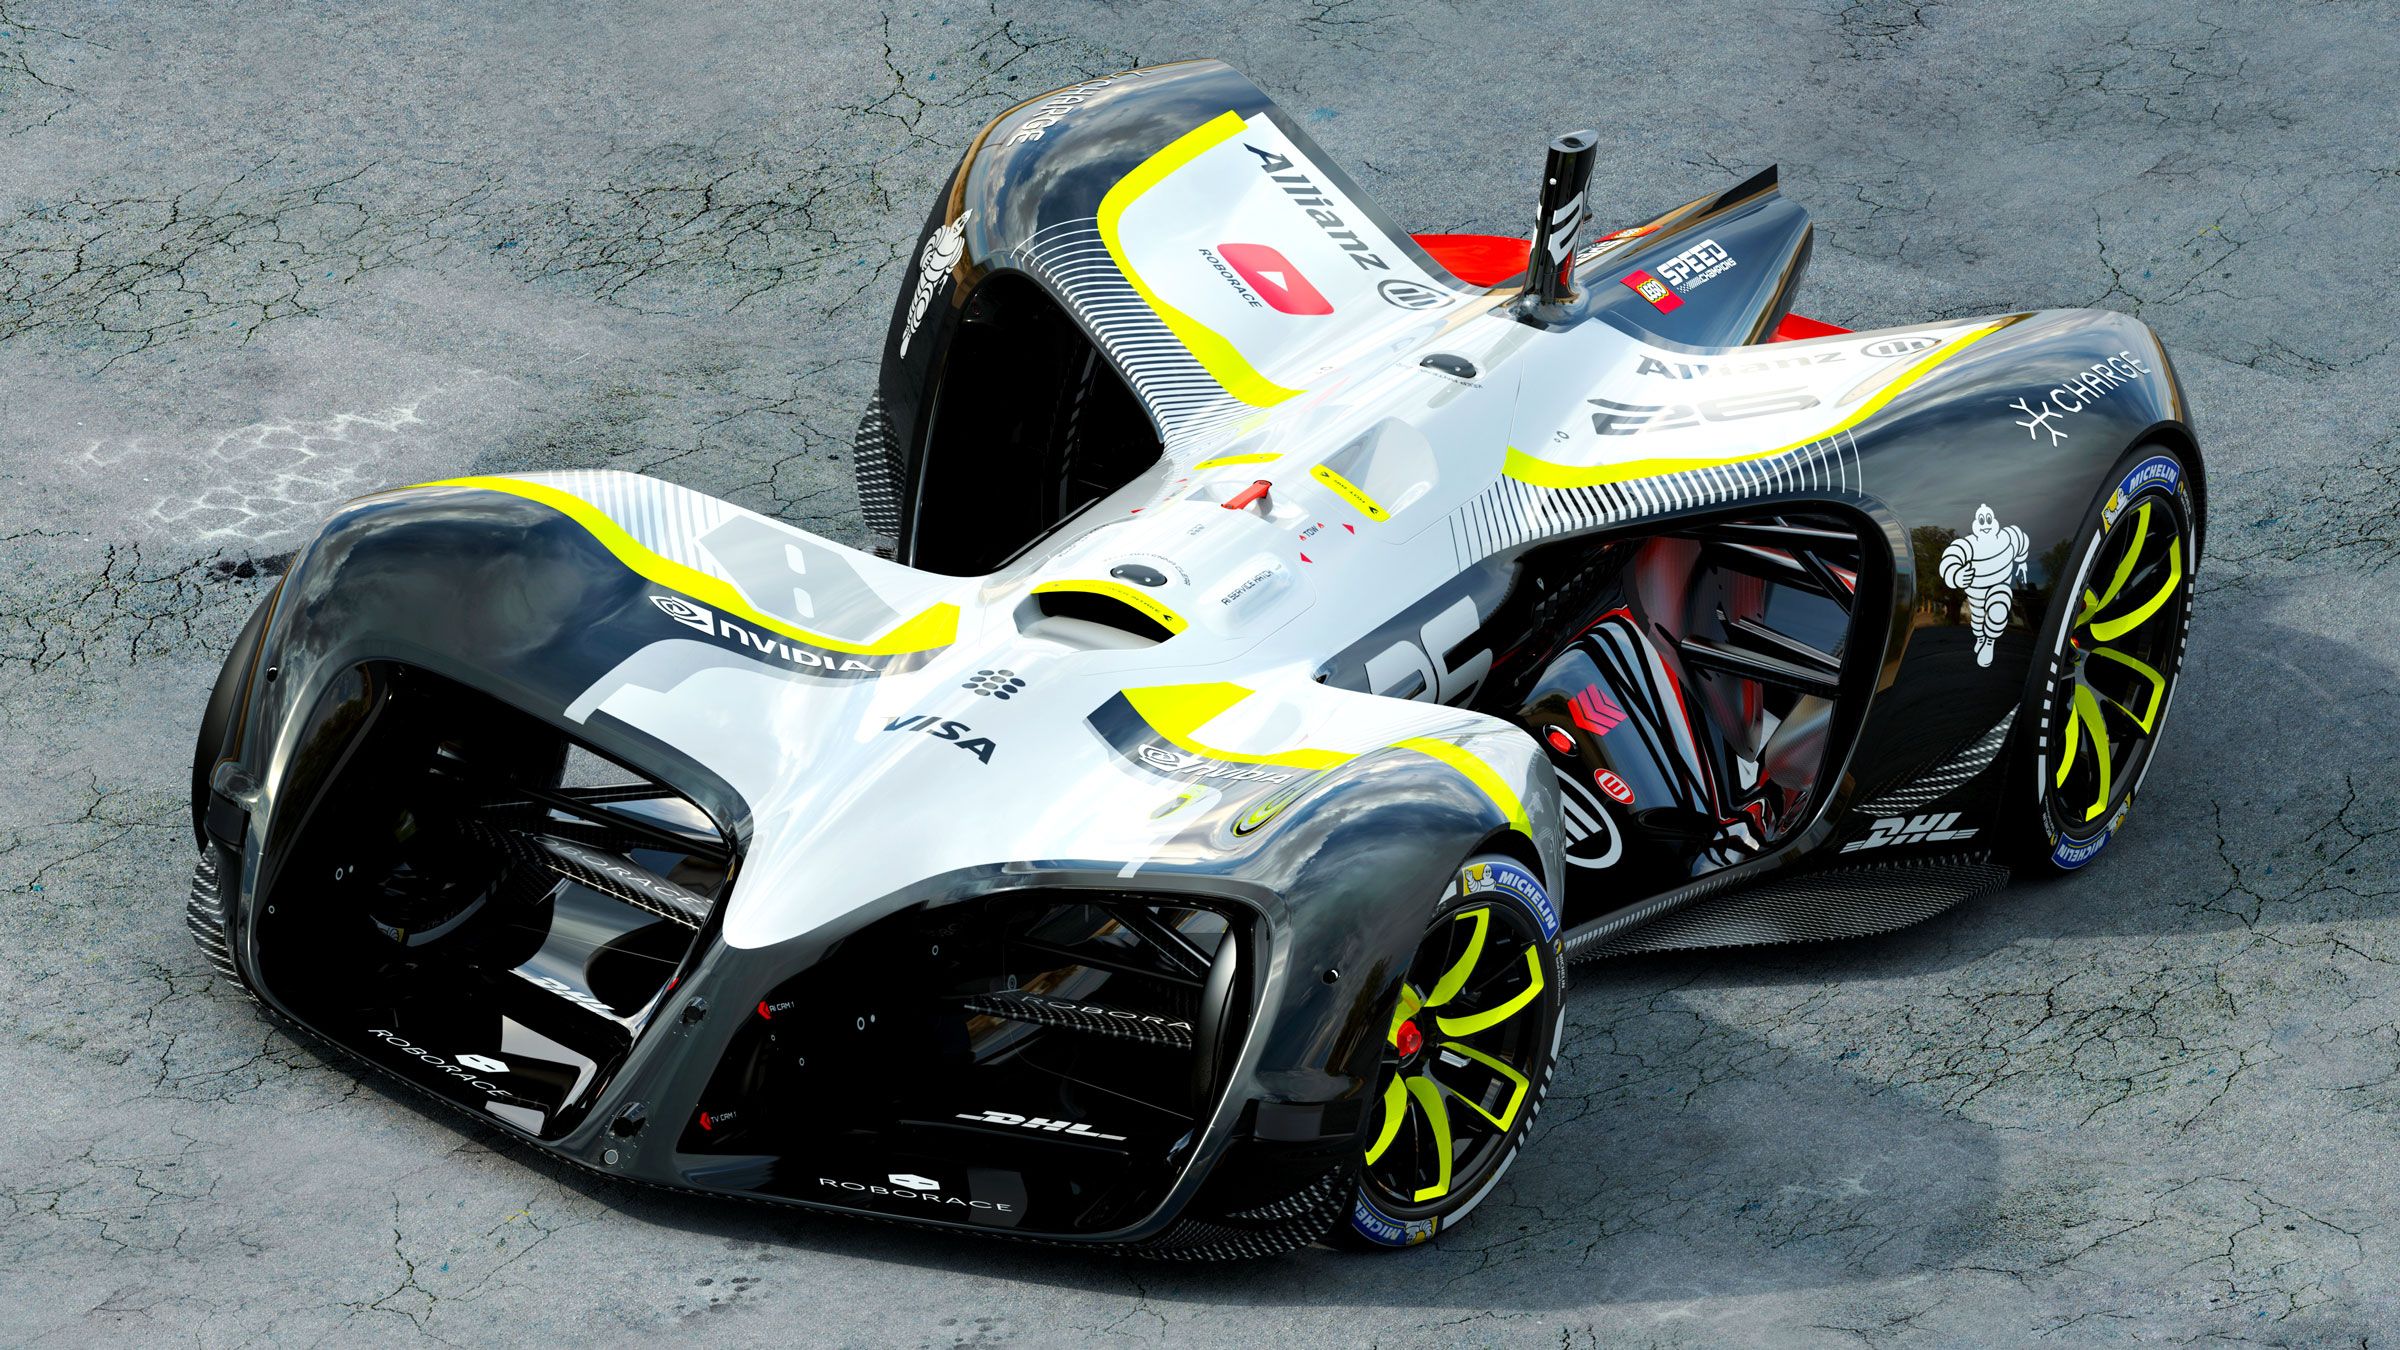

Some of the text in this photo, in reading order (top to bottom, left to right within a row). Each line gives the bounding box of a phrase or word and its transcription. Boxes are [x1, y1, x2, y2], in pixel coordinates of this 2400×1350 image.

[1006, 78, 1113, 148] CHARGE
[1244, 143, 1391, 271] Allianz
[1199, 249, 1262, 309] ROBORACE
[1656, 238, 1728, 287] SPEED
[1699, 257, 1737, 284] CHAMPIONS
[1639, 280, 1668, 302] LEGO
[1635, 352, 1847, 380] Allianz
[2053, 350, 2152, 413] CHARGE
[2129, 464, 2177, 493] MICHELIN
[1303, 525, 1319, 537] TOW
[1228, 581, 1256, 600] SERVICE
[882, 714, 997, 765] VISA
[1866, 812, 1962, 846] DHL
[2057, 833, 2107, 862] MICHELIN
[1498, 870, 1557, 931] MICHELIN
[776, 1003, 790, 1011] CAM
[1021, 995, 1193, 1031] ROBORA
[368, 1028, 512, 1098] ROBORACE
[720, 1112, 734, 1121] CAM
[978, 1110, 1100, 1136] DHL
[819, 1177, 1013, 1213] ROBORACE
[1353, 1199, 1402, 1240] MICHEL
